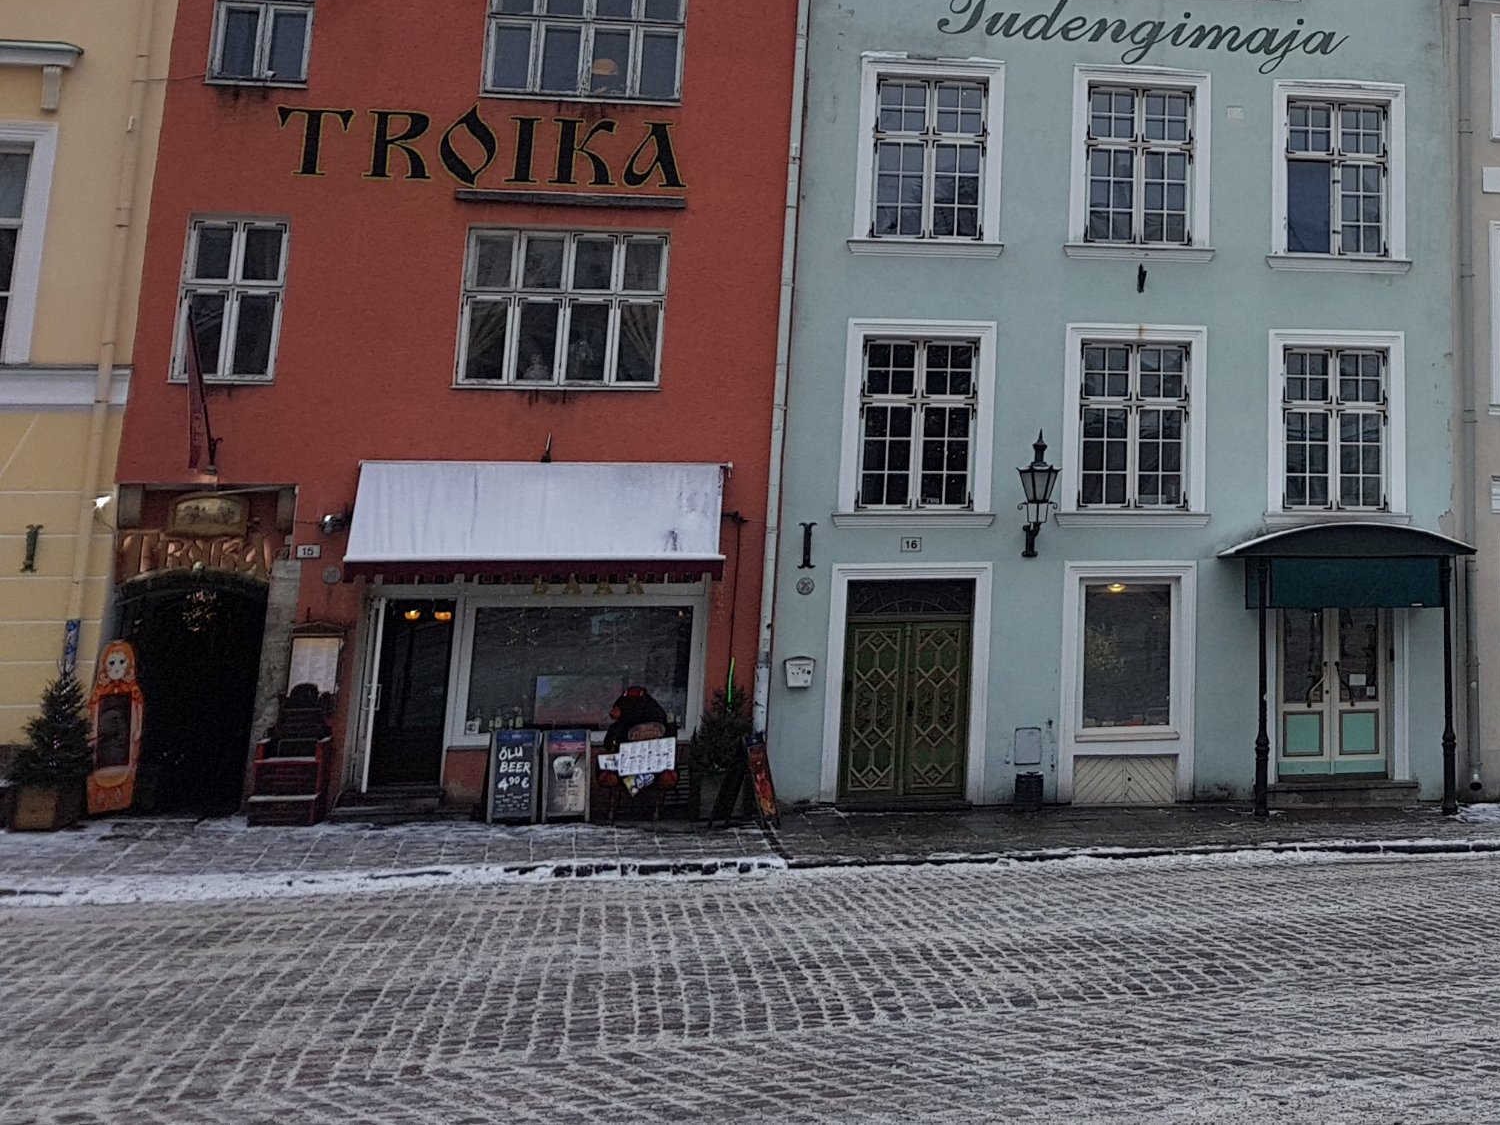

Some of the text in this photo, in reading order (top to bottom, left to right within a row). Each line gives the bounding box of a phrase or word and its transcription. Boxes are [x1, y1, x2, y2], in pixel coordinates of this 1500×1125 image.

[276, 103, 687, 189] TROIKA
[905, 539, 918, 549] 16
[302, 546, 315, 556] 15
[499, 761, 532, 775] BEER
